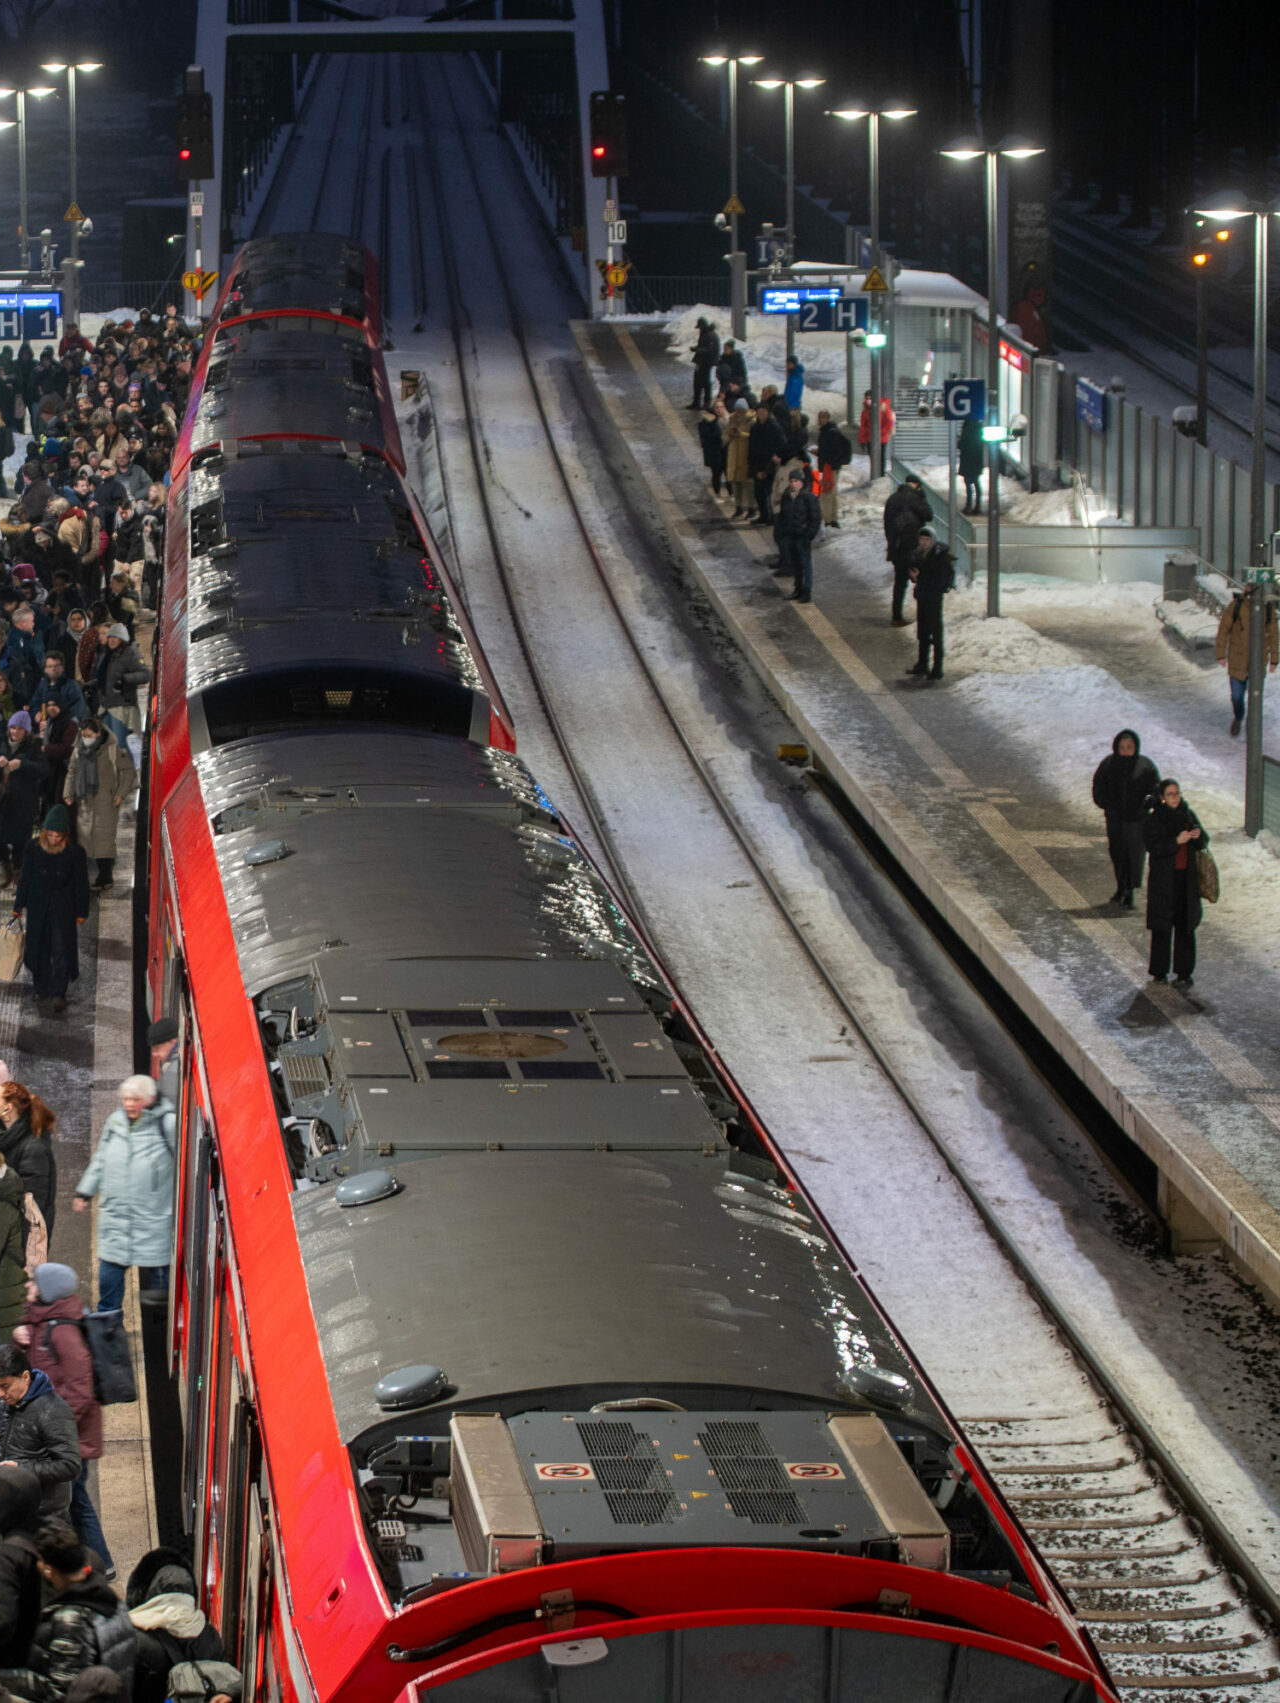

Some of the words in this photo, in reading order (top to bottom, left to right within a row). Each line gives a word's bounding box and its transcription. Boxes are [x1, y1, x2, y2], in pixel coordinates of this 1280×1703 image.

[609, 223, 625, 240] 10
[0, 311, 18, 337] H
[39, 311, 54, 336] 1
[802, 303, 818, 328] 2
[837, 302, 856, 328] H
[948, 385, 971, 416] G
